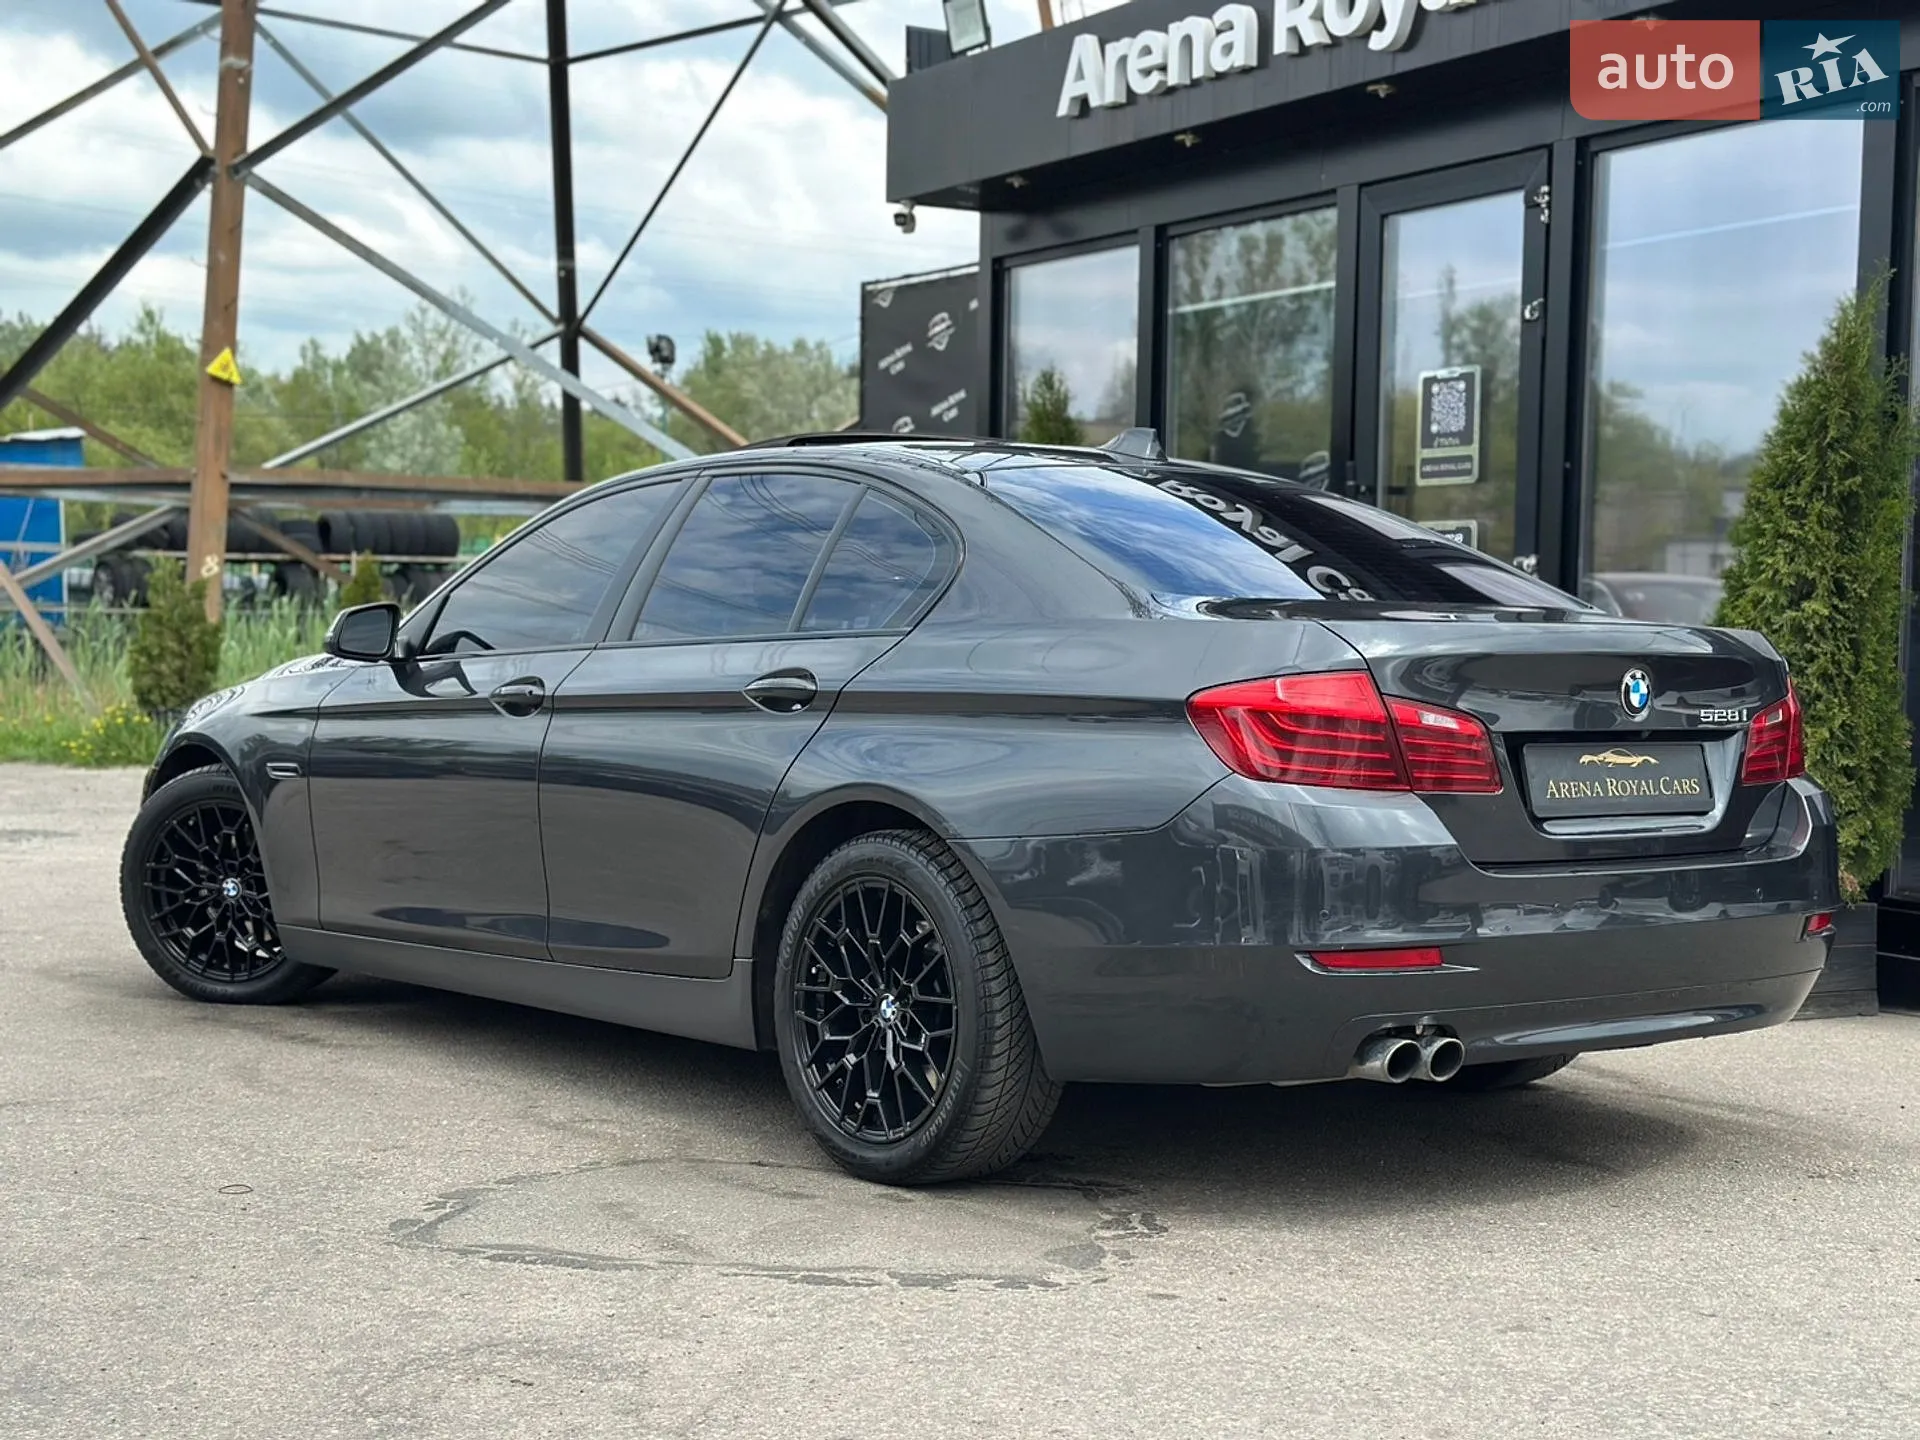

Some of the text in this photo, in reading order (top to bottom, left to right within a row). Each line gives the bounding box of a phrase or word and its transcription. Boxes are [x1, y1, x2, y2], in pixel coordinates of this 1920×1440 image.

[1056, 0, 1477, 117] Arena Roy
[1700, 709, 1748, 722] 528i
[1546, 776, 1700, 799] ARENA ROYAL CARS
